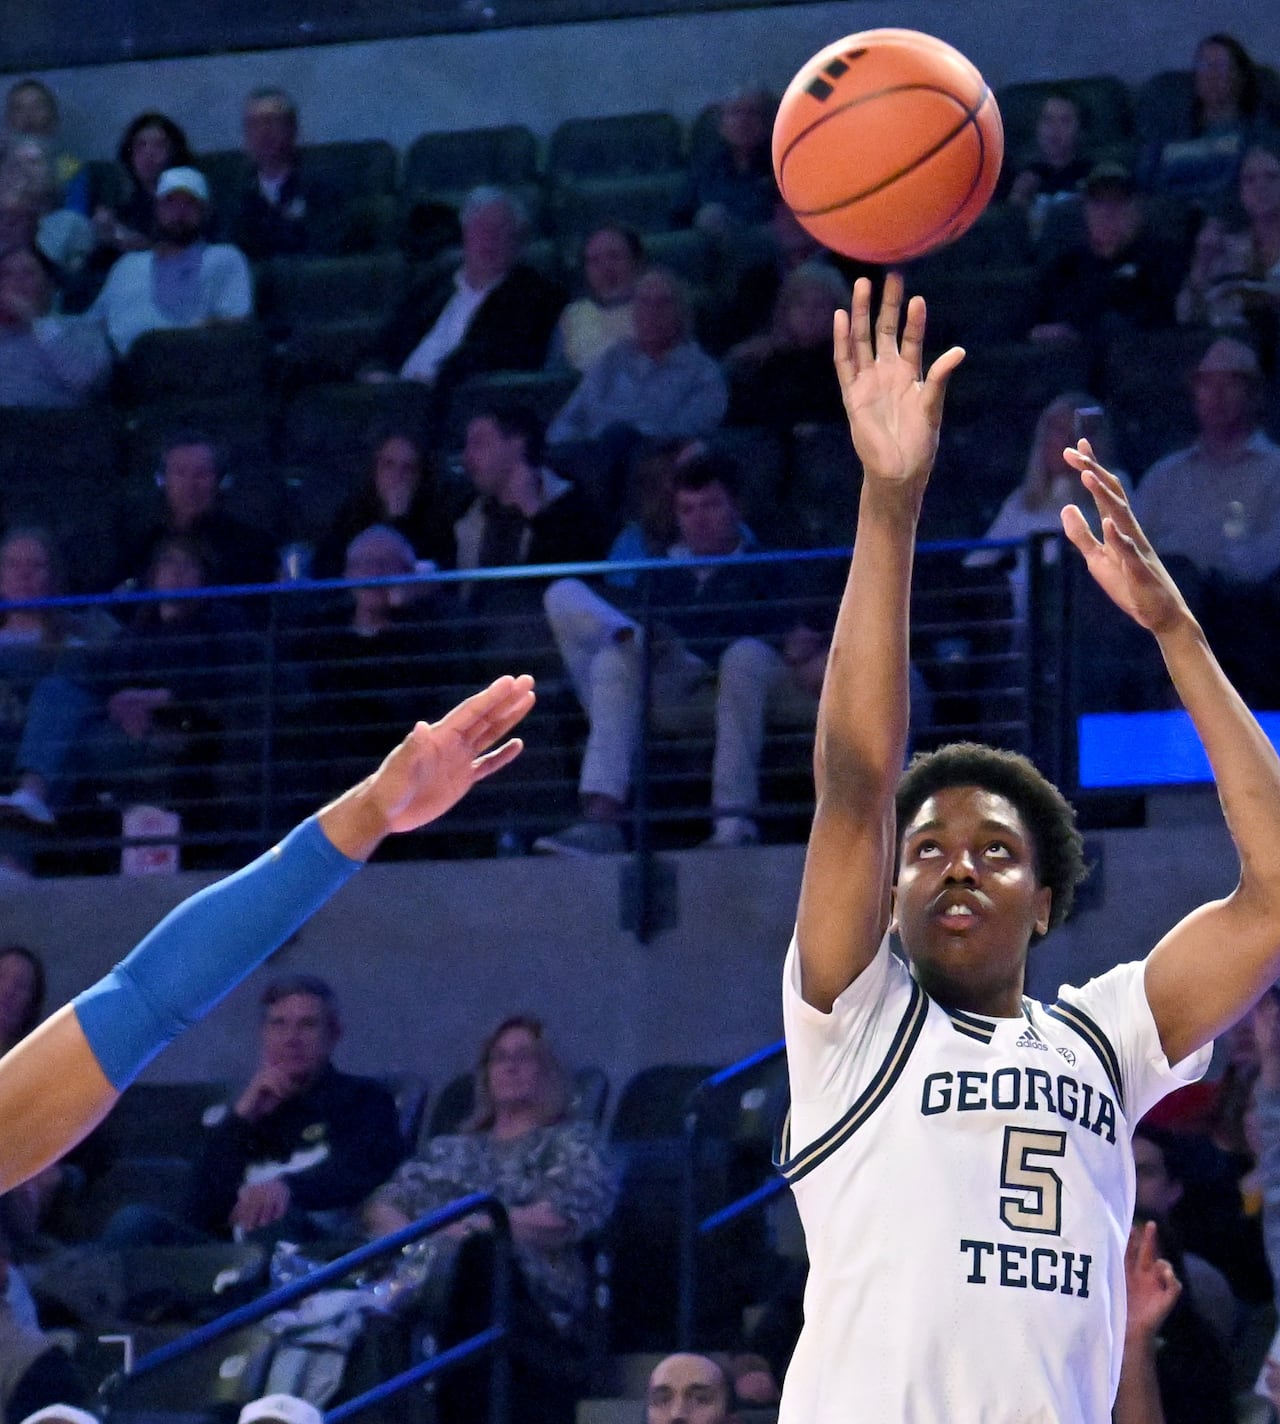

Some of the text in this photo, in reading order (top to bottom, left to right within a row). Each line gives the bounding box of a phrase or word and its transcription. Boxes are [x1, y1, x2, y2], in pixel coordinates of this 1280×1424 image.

[1016, 1040, 1049, 1052] adidas
[921, 1067, 1117, 1146] GEORGIA
[999, 1125, 1068, 1237] 5
[960, 1239, 1093, 1299] TECH
